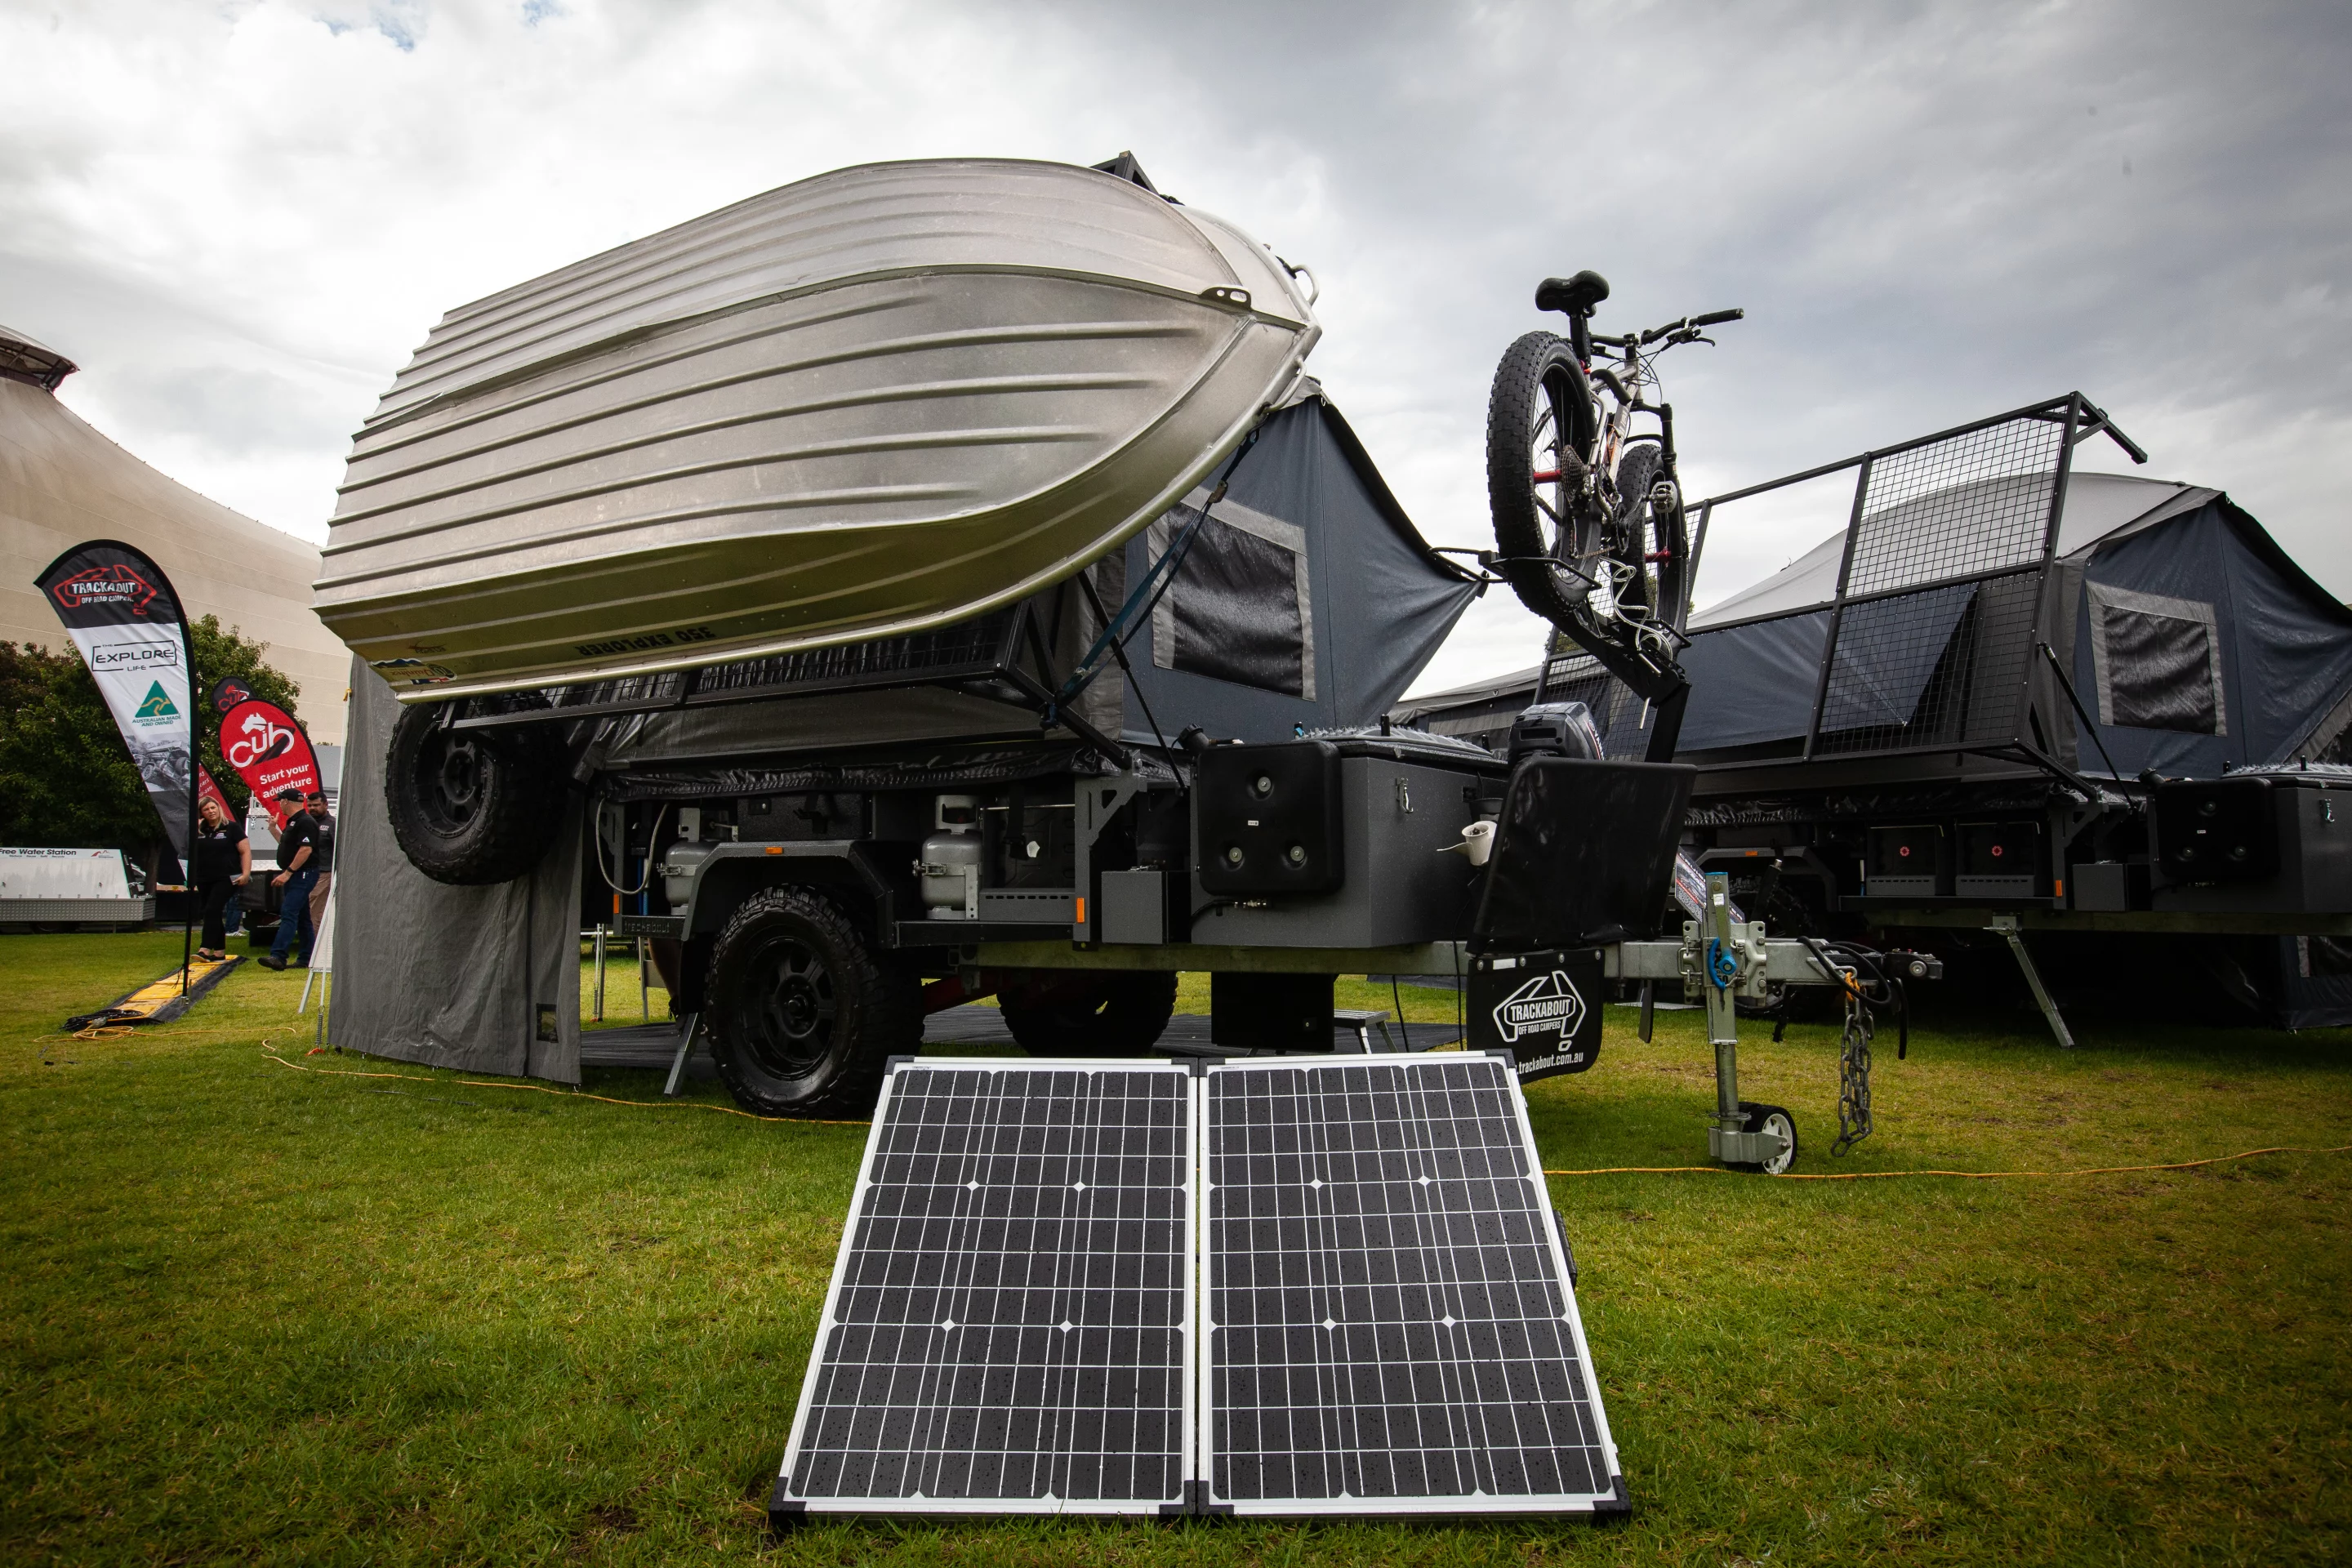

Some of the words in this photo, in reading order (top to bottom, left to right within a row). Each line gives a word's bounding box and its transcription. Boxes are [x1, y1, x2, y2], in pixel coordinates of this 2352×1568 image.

[72, 581, 136, 595] TRACKAOUT
[82, 596, 92, 604] OFF
[675, 626, 717, 642] 350
[575, 633, 675, 657] EXPLORER
[96, 649, 174, 663] EXPLORE
[259, 768, 285, 785] Start
[286, 764, 310, 777] your
[262, 777, 312, 799] adventure
[1510, 999, 1570, 1022] TRACKABOUT
[1518, 1026, 1527, 1036] OFF
[1528, 1024, 1539, 1034] ROAD
[1539, 1021, 1561, 1032] CAMPERS
[1515, 1052, 1584, 1076] .trackabout.com.au
